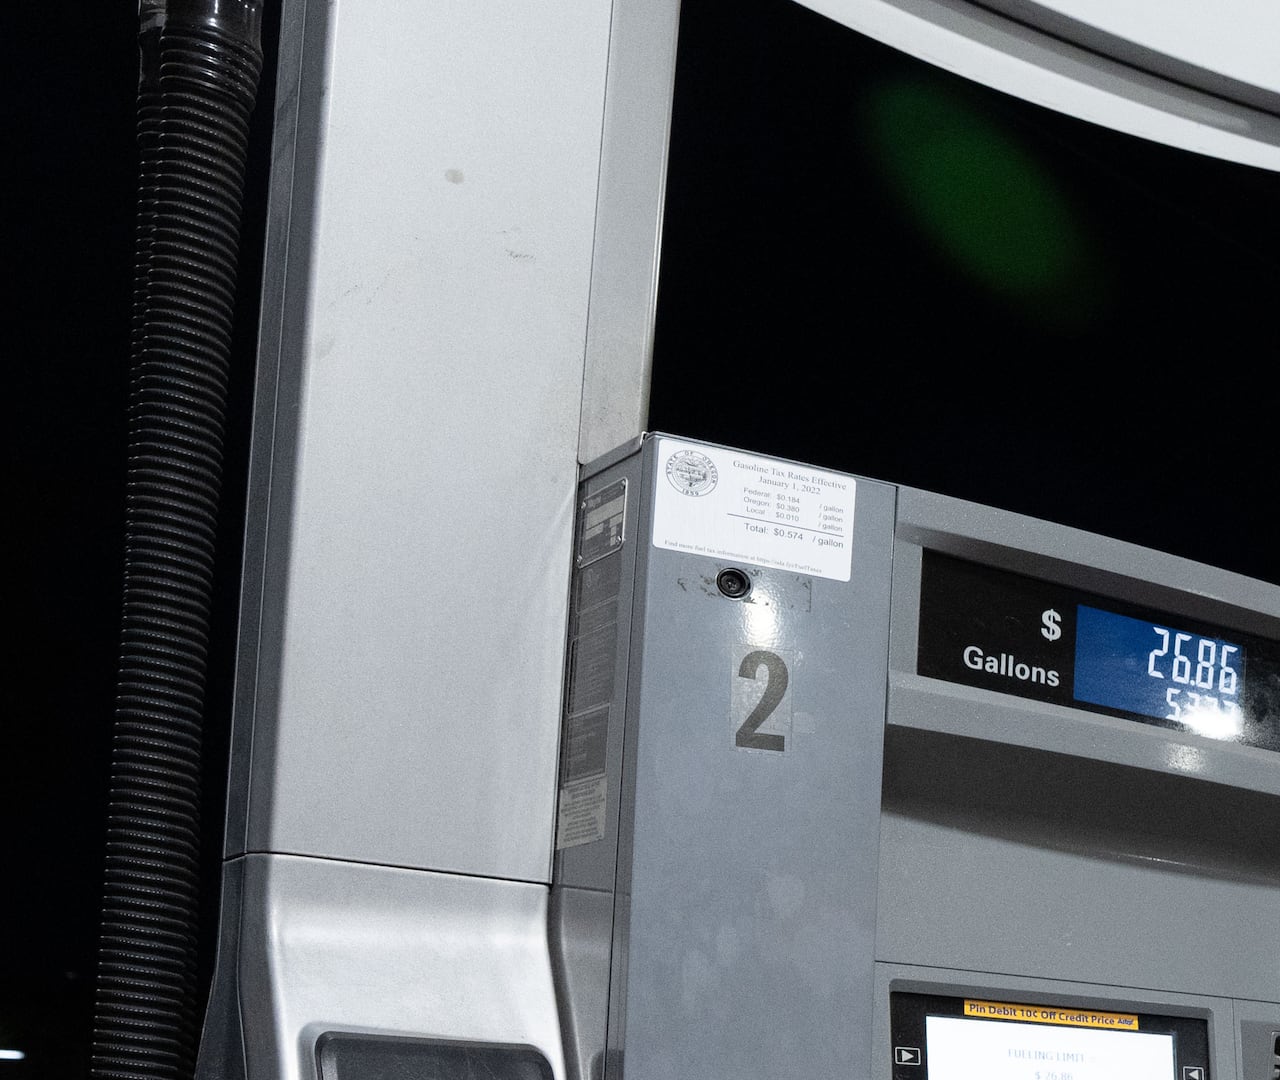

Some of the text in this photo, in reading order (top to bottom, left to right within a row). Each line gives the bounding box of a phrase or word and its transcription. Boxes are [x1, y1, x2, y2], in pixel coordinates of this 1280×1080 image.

[733, 460, 847, 491] Gasoline Tax Rates Effective
[759, 475, 789, 490] January
[801, 484, 821, 495] 2022
[744, 523, 768, 535] Total:
[773, 527, 803, 541] $0.574
[818, 537, 844, 549] gallon
[963, 645, 1060, 688] Gallons
[1040, 608, 1238, 695] $ 26.86
[735, 650, 789, 752] 2
[969, 1003, 985, 1014] Pin
[988, 1005, 1017, 1017] Debit
[1020, 1008, 1037, 1018] 10¢
[1041, 1010, 1056, 1020] Off
[1059, 1012, 1089, 1023] Credit
[1091, 1015, 1115, 1025] Price
